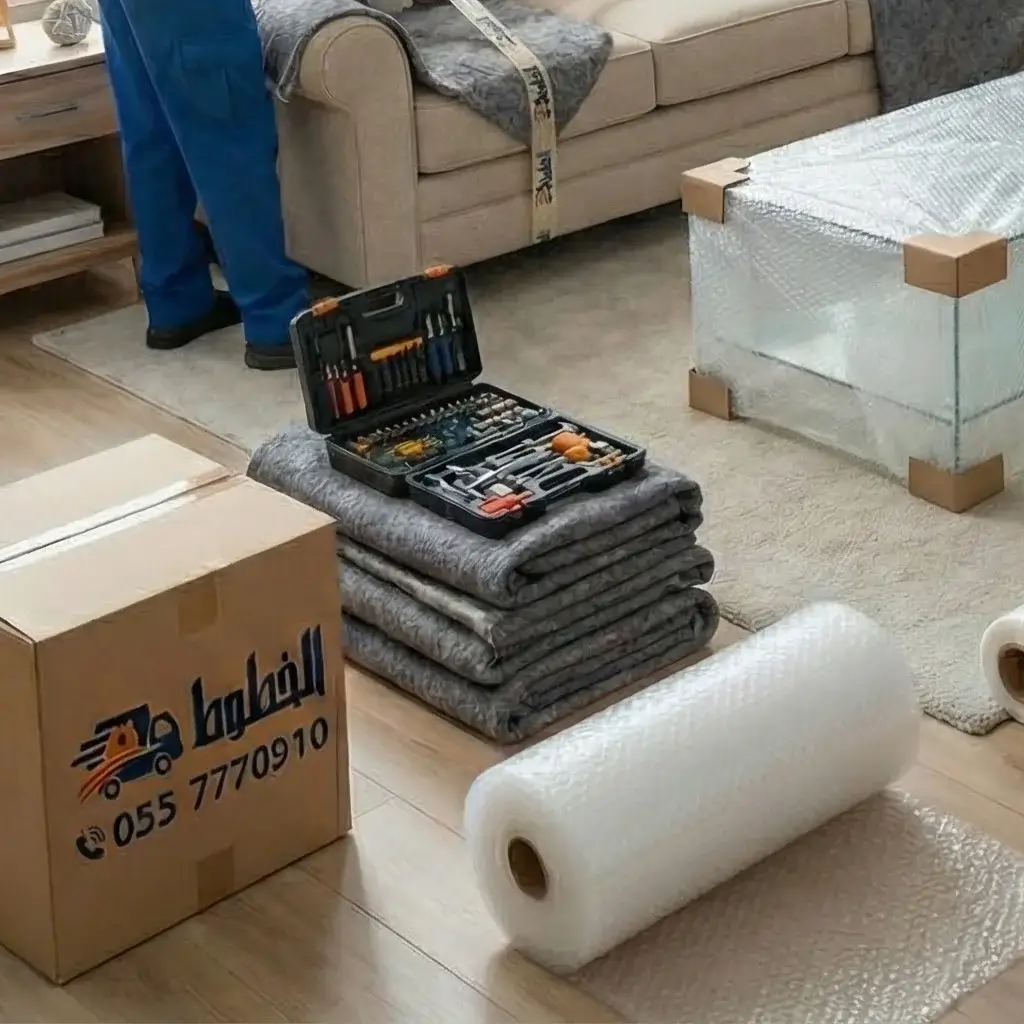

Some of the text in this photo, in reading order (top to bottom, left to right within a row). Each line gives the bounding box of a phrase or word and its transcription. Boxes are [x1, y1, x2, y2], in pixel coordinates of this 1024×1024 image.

[190, 624, 326, 750] الخطوط
[112, 716, 329, 847] 055 7770910
